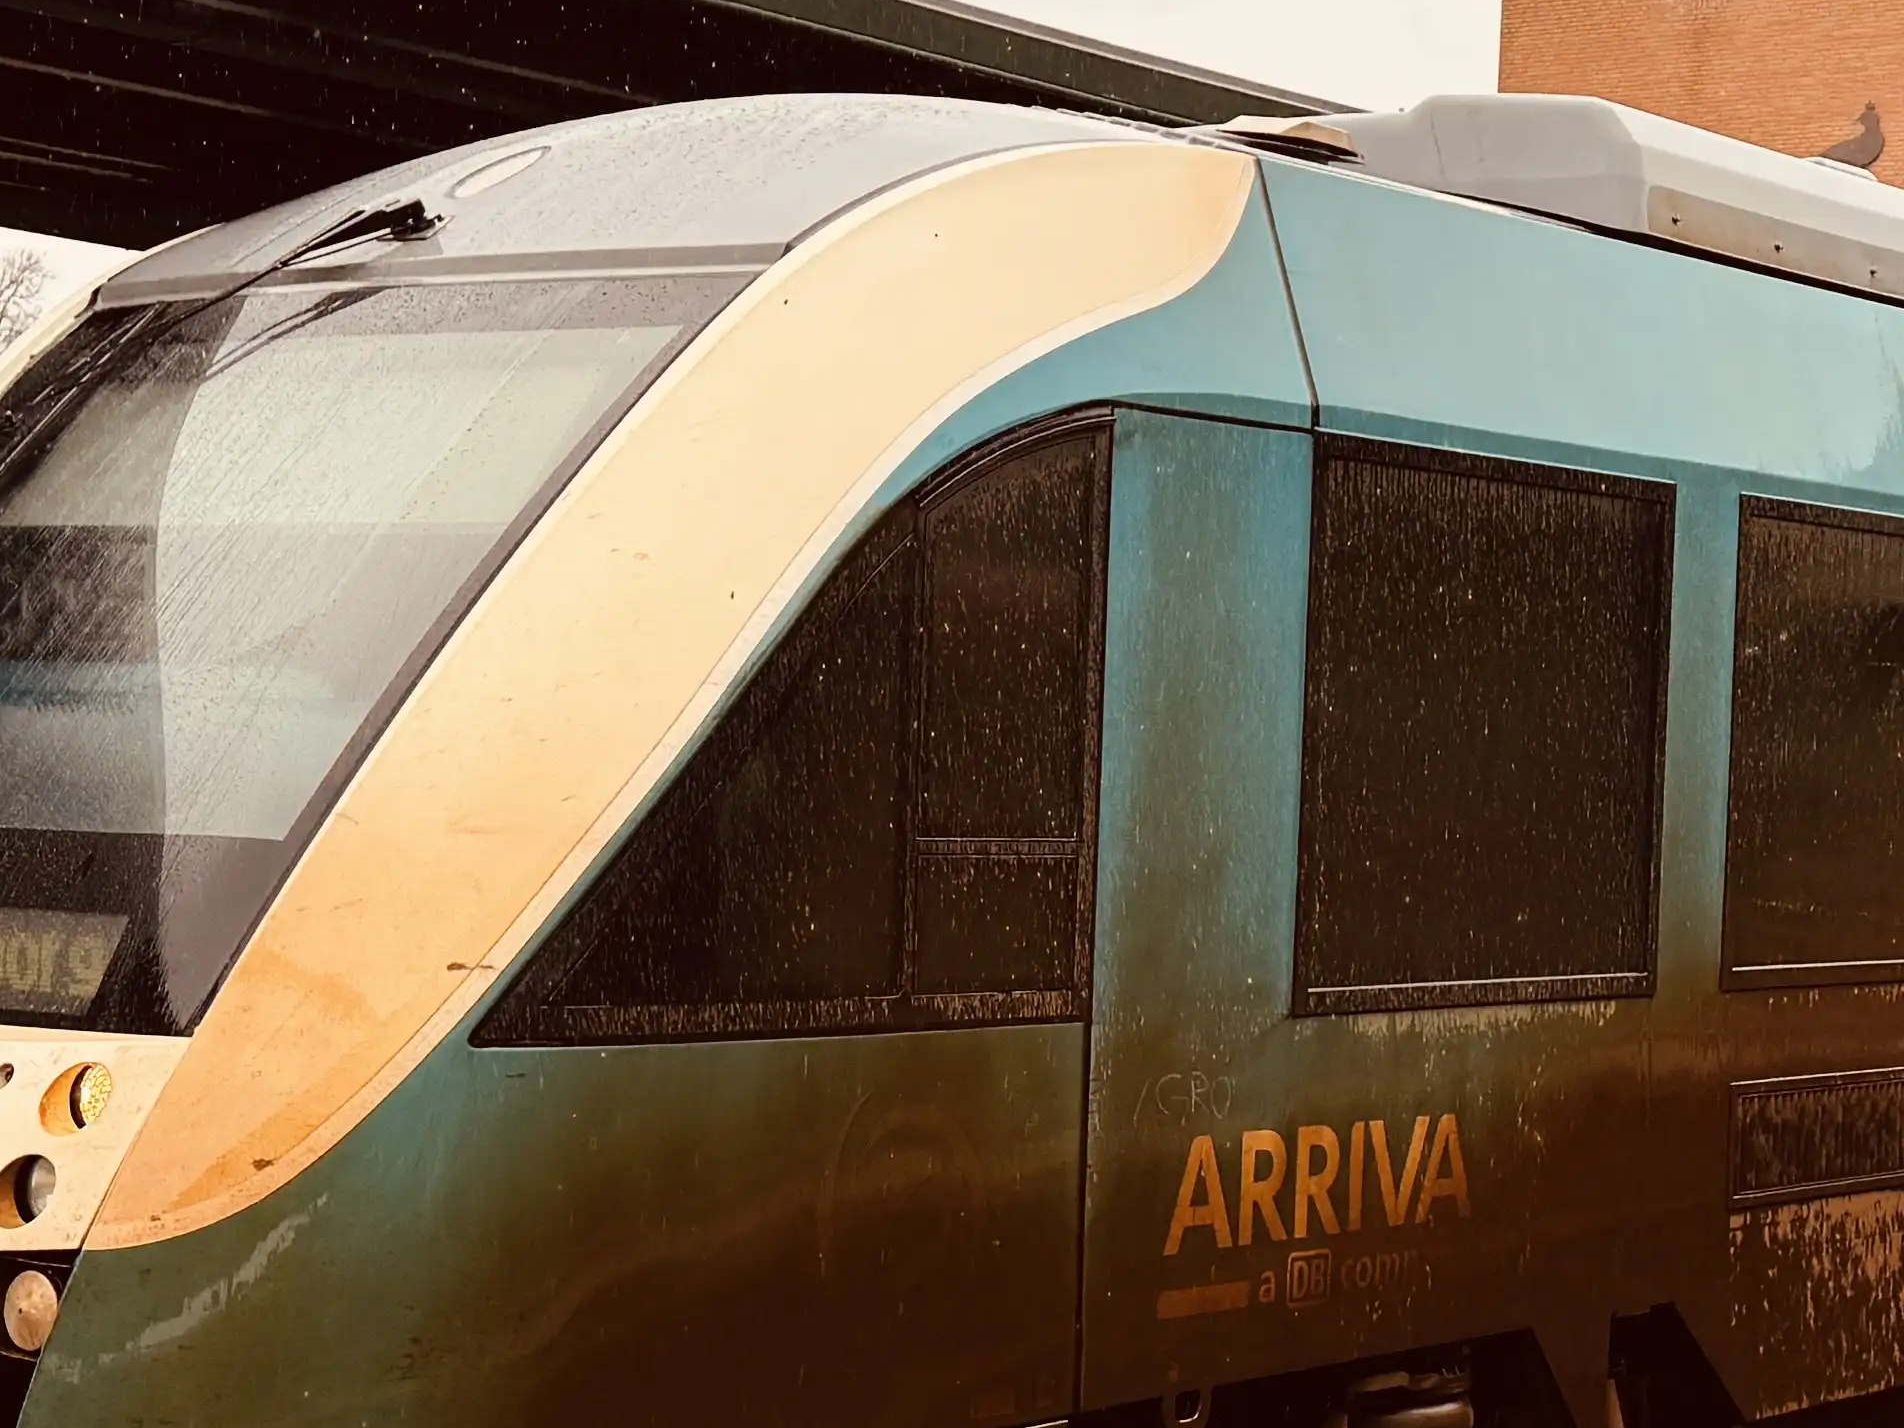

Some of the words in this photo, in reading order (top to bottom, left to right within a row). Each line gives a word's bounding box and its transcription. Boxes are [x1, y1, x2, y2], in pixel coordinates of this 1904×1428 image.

[1162, 1112, 1471, 1257] ARRIVA
[1258, 1270, 1276, 1303] a
[1290, 1255, 1330, 1302] DB
